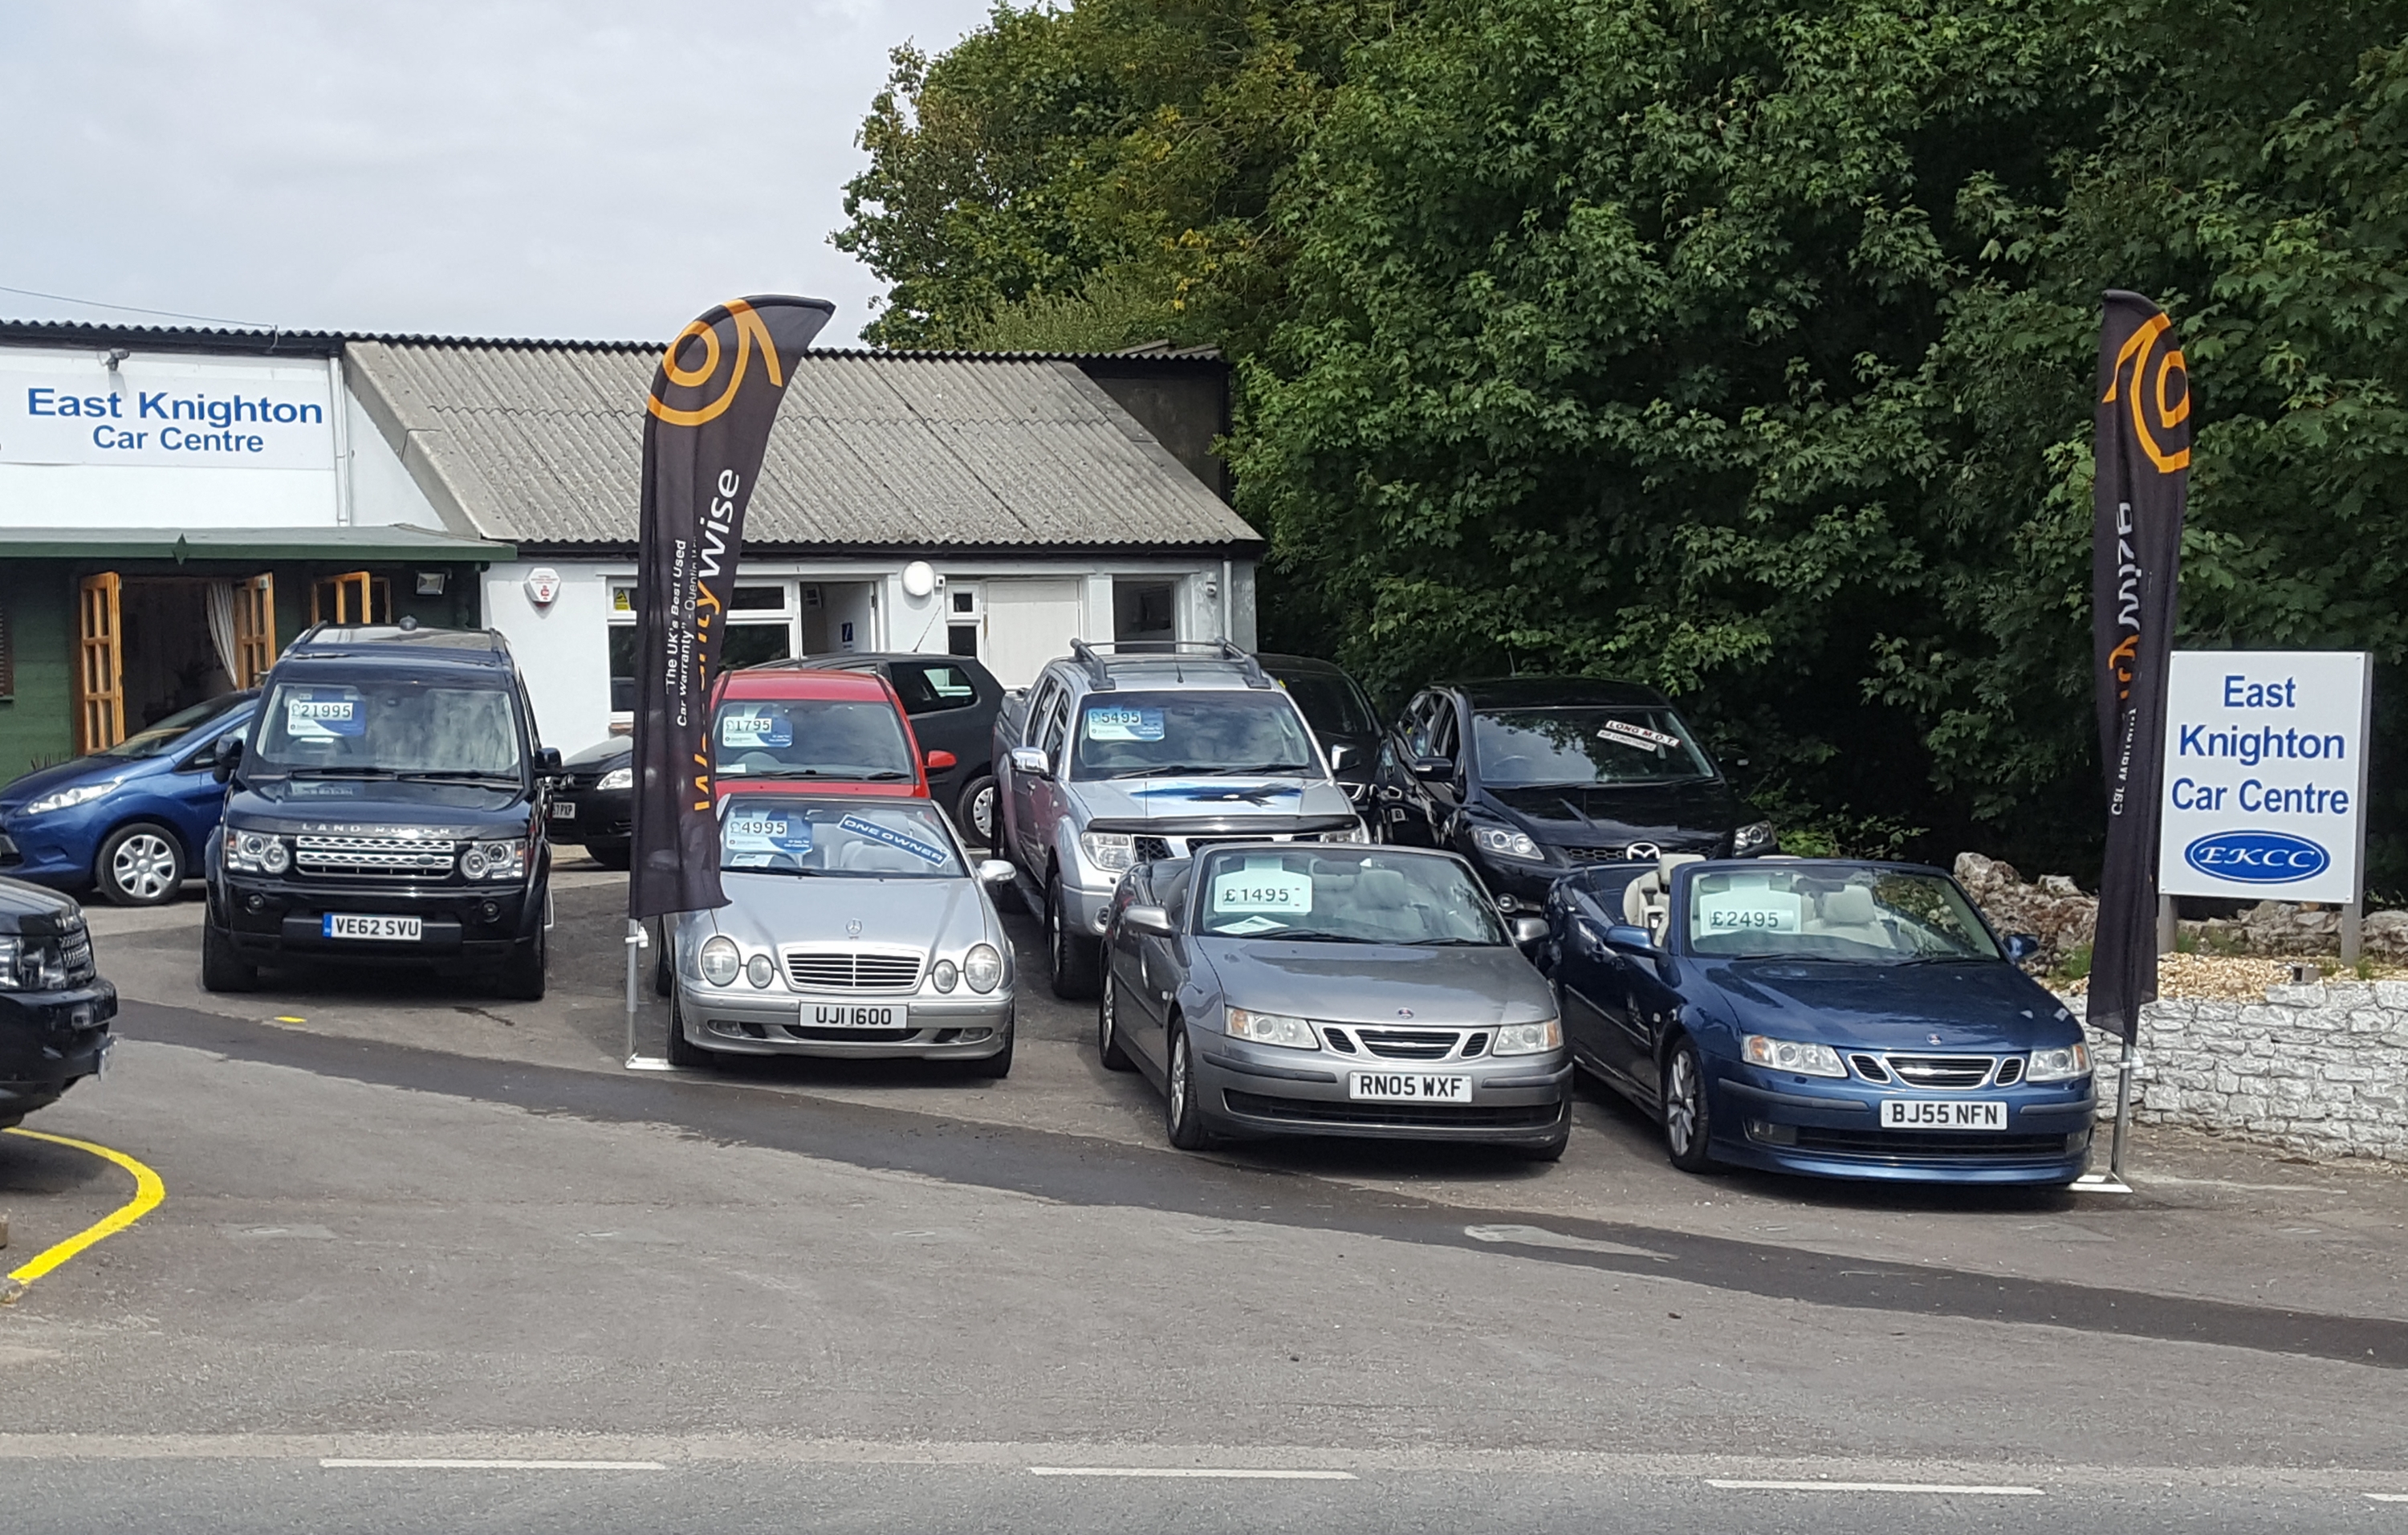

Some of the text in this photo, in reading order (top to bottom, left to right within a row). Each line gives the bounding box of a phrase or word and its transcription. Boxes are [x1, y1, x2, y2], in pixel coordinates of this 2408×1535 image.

[28, 388, 322, 429] East Knighton
[93, 425, 264, 453] Car Centre
[673, 539, 686, 578] Used
[671, 582, 681, 616] Best
[667, 621, 679, 654] UK's
[2224, 675, 2296, 707] East
[291, 704, 351, 718] £21995
[677, 699, 687, 727] Car
[1092, 711, 1139, 723] £5495
[726, 720, 770, 731] £1795
[1609, 722, 1639, 734] LONG
[2179, 724, 2345, 766] Knighton
[2172, 777, 2349, 814] Car Centre
[302, 823, 361, 833] LAND
[730, 821, 786, 835] £4995
[844, 820, 943, 861] ONE OWNER
[2199, 847, 2316, 868] EKCC
[1224, 888, 1288, 902] £1495
[336, 918, 418, 936] VE62 SVU
[1711, 911, 1778, 928] £2495
[1361, 1075, 1462, 1097] RN05 WXF
[1892, 1103, 1997, 1125] BJ55 NFN
